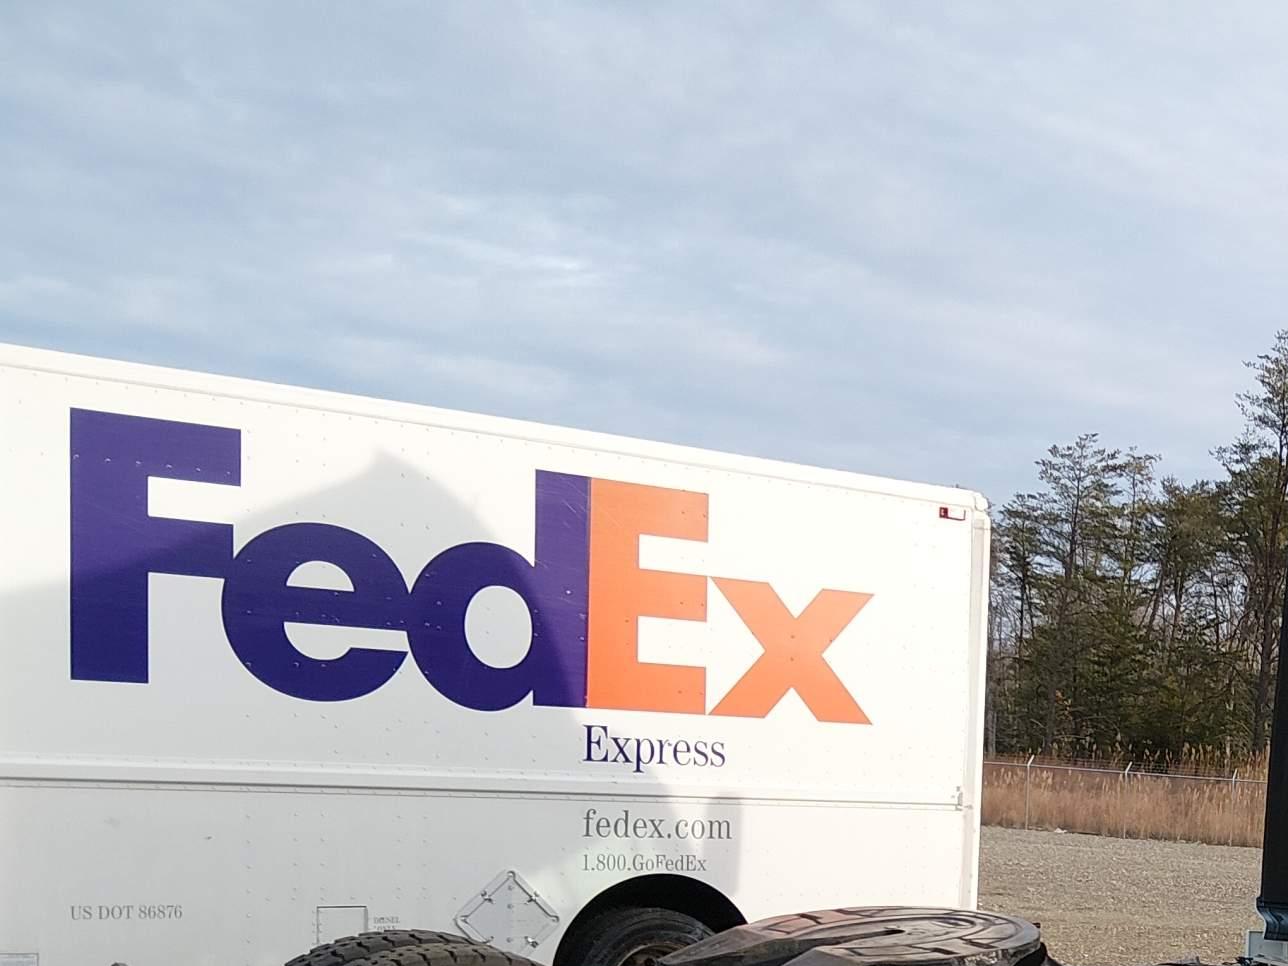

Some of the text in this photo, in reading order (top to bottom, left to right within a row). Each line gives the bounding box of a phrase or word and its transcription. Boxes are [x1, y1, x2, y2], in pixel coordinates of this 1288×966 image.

[70, 407, 874, 725] FedEx
[583, 724, 726, 773] Express
[583, 808, 733, 840] fedex.com
[582, 854, 707, 872] 1.800.GoFedEx
[70, 904, 183, 920] US DOT 86876
